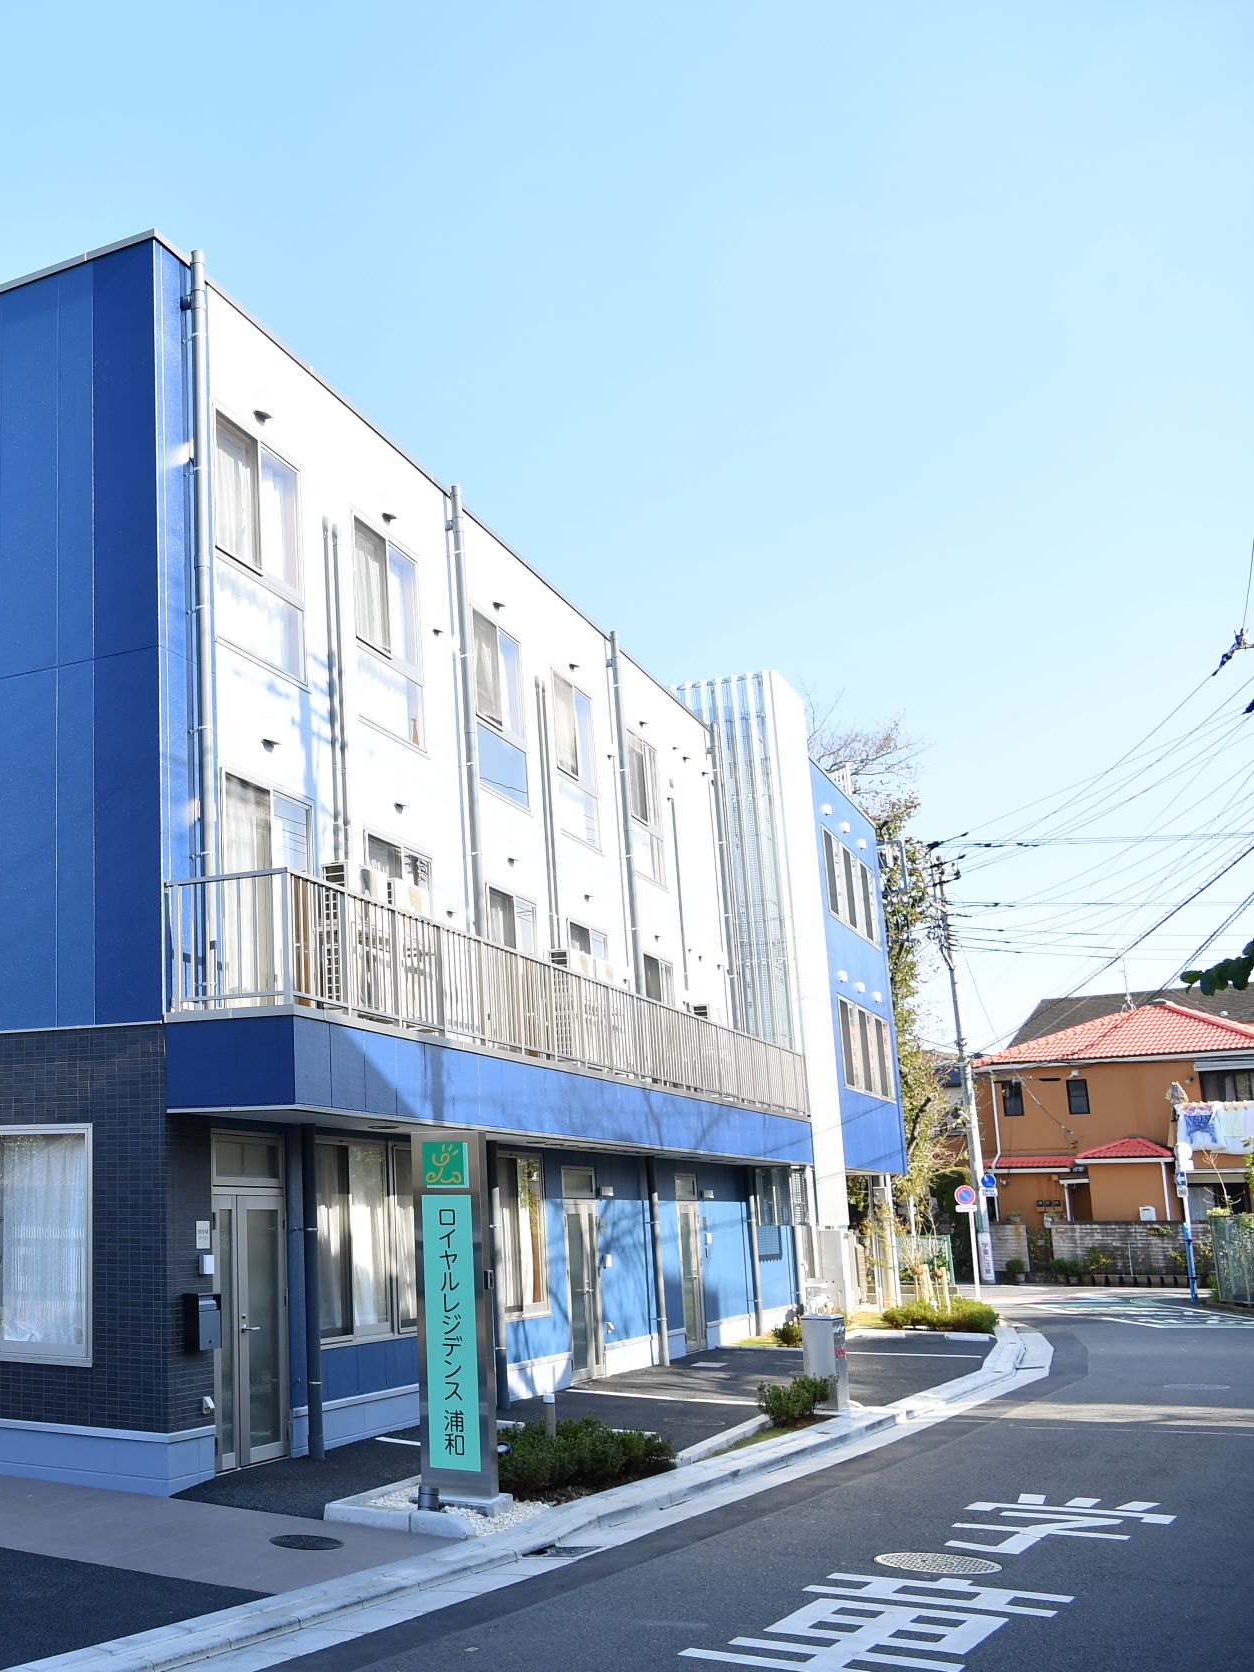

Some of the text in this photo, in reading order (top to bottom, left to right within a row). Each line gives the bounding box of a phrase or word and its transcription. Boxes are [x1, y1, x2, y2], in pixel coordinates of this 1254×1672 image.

[438, 1208, 465, 1457] ロイヤルレジデンス 浦和
